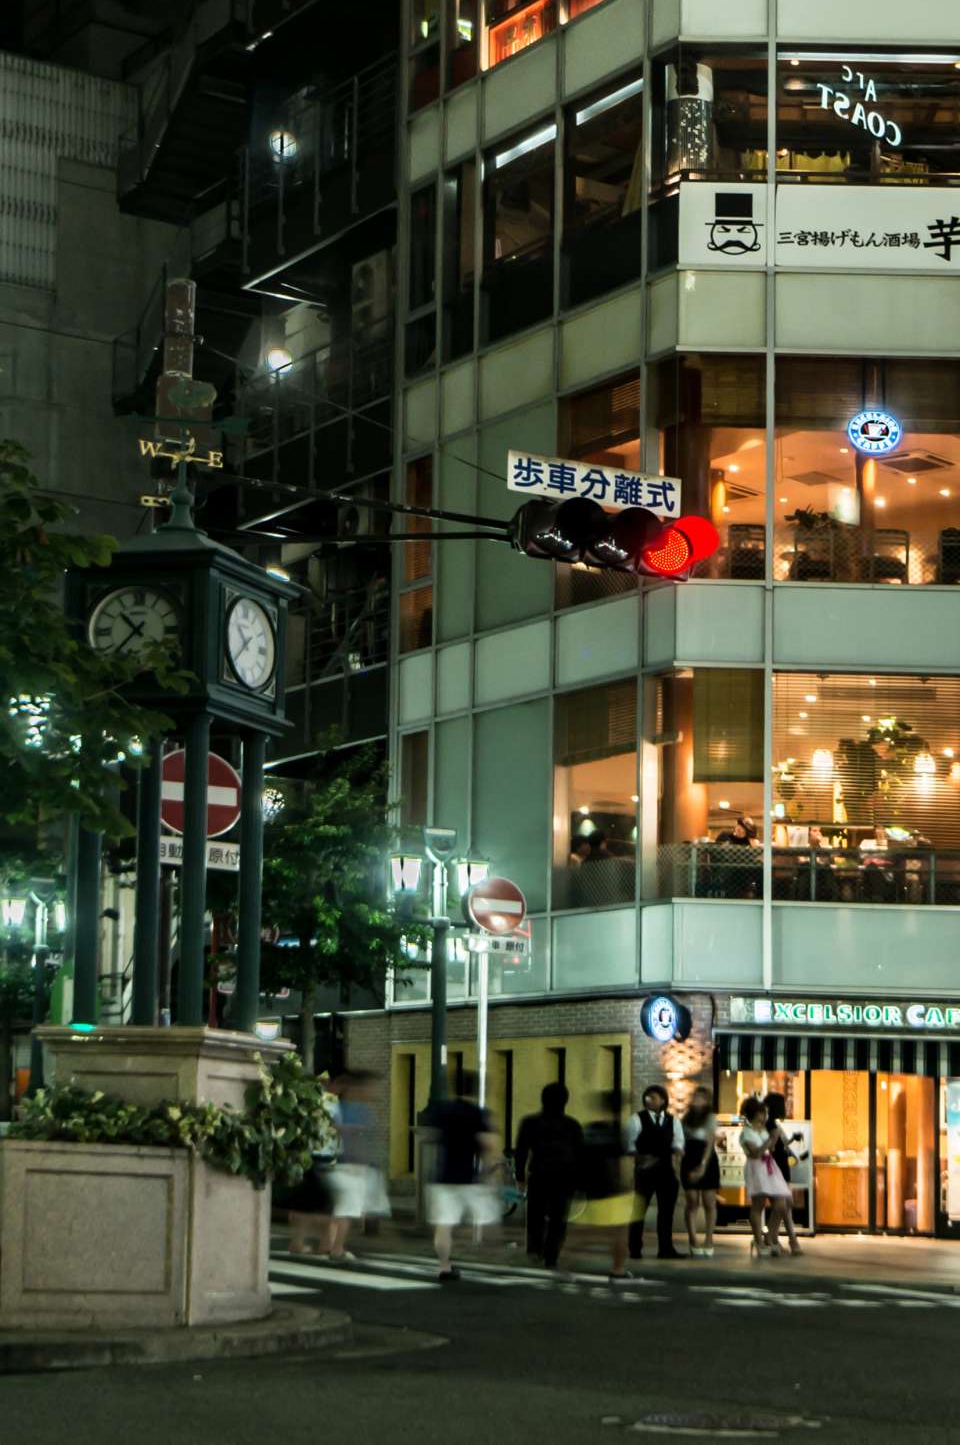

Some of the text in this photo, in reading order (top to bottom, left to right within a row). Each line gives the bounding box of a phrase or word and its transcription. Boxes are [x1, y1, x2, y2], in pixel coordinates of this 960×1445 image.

[776, 228, 921, 250] 三宮揚げもん酒場
[208, 451, 223, 468] E
[513, 457, 676, 512] 歩車分離式
[754, 999, 902, 1026] EXCELSIOR
